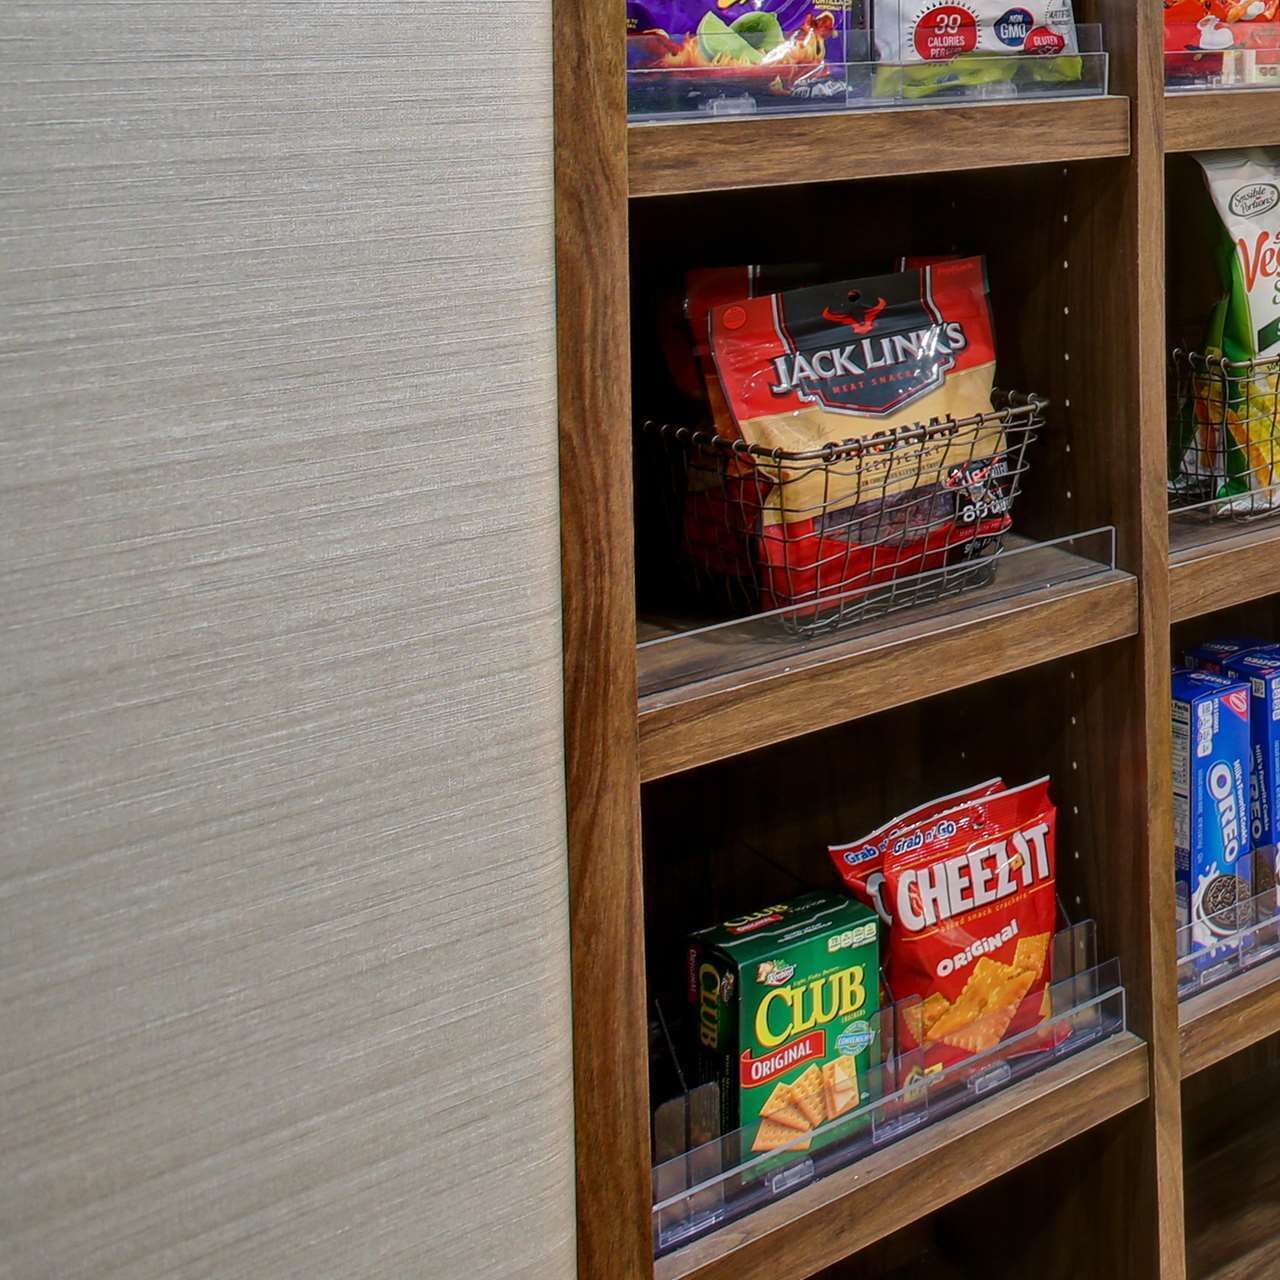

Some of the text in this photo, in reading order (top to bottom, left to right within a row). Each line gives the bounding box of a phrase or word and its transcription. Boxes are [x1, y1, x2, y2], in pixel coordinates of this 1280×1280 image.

[927, 36, 966, 48] CALORIES
[934, 13, 961, 36] 39
[1000, 23, 1027, 39] GMO
[771, 322, 967, 394] JACK LINK'S
[1208, 761, 1239, 863] OREO
[893, 834, 923, 855] Grab
[937, 819, 957, 838] Go
[844, 846, 879, 865] Grab
[755, 964, 866, 1048] CLUB
[751, 1039, 813, 1081] ORIGINAL
